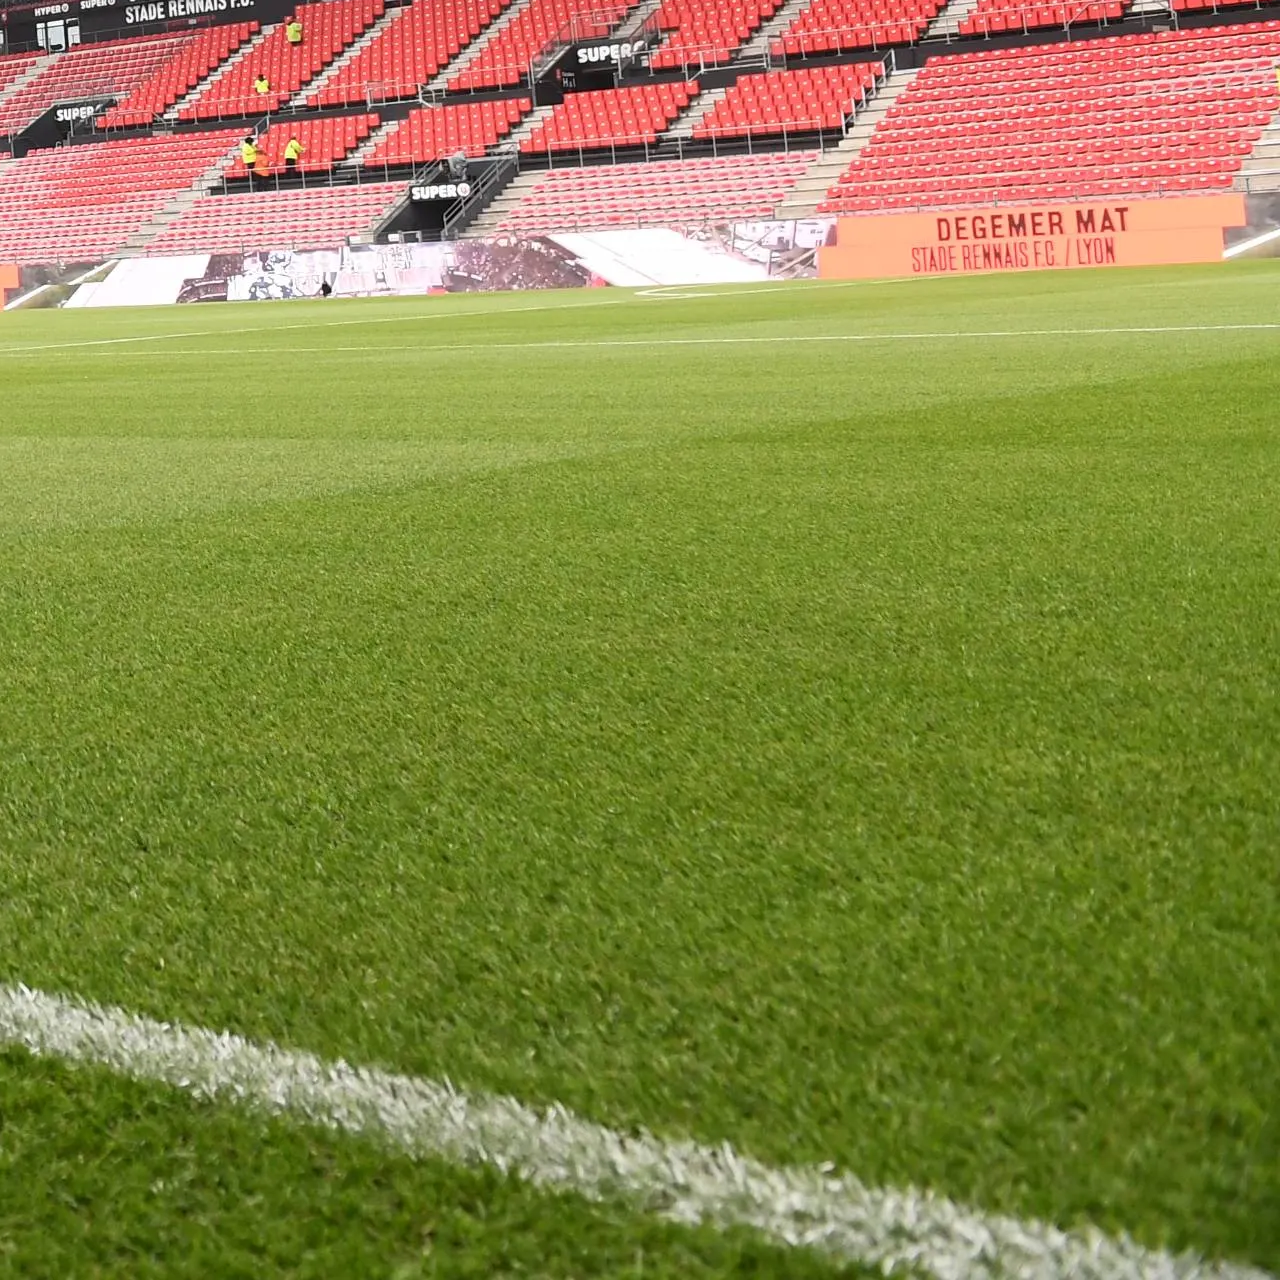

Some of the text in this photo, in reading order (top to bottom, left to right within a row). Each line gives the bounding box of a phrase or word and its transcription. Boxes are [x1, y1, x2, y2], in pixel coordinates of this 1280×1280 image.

[34, 5, 61, 17] HYPER
[125, 2, 165, 24] STADE
[577, 43, 632, 64] SUPER
[56, 106, 94, 121] SUPER
[411, 184, 457, 200] SUPER
[937, 207, 1129, 241] DEGEMER MAT
[912, 245, 957, 272] STADE
[962, 241, 1028, 270] RENNAIS
[1033, 241, 1059, 266] F.C.
[1076, 237, 1116, 265] LYON
